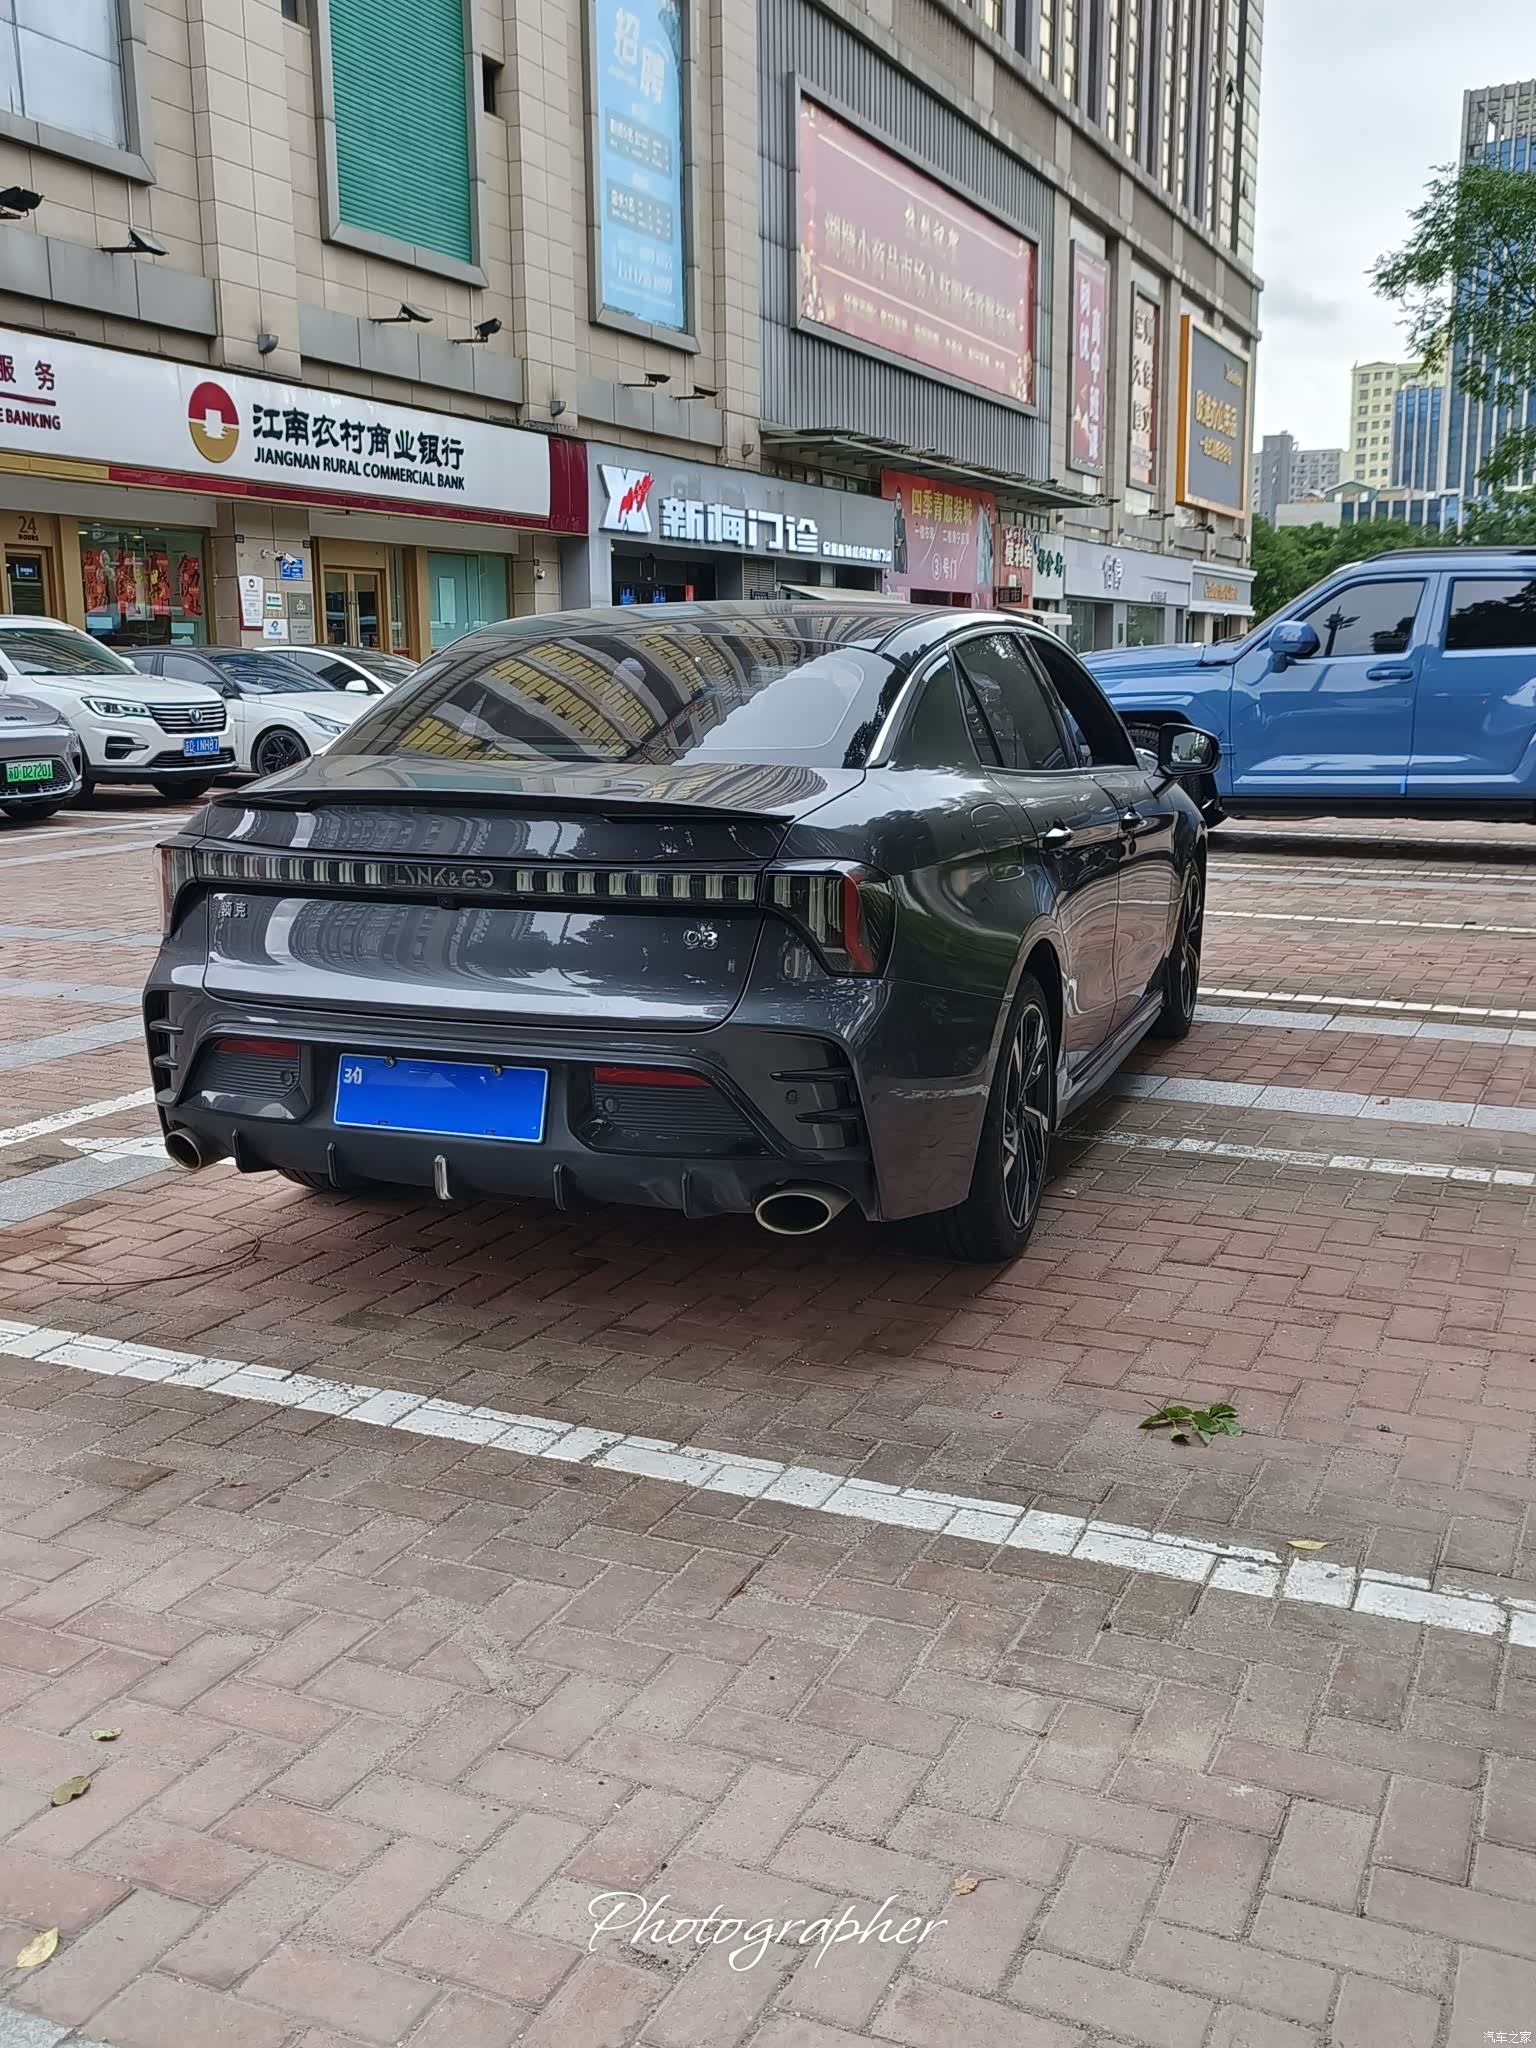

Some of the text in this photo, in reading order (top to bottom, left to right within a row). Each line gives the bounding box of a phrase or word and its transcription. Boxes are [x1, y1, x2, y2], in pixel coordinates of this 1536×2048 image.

[5, 408, 61, 430] BANKING
[253, 404, 465, 470] 江南农村商业银行
[254, 447, 465, 491] JIANGNAN RURAL COMMERCIAL BANK
[18, 515, 37, 534] 24
[659, 497, 819, 554] 新梅门诊
[911, 488, 973, 526] 四季青服装城
[1005, 542, 1033, 569] 便利店
